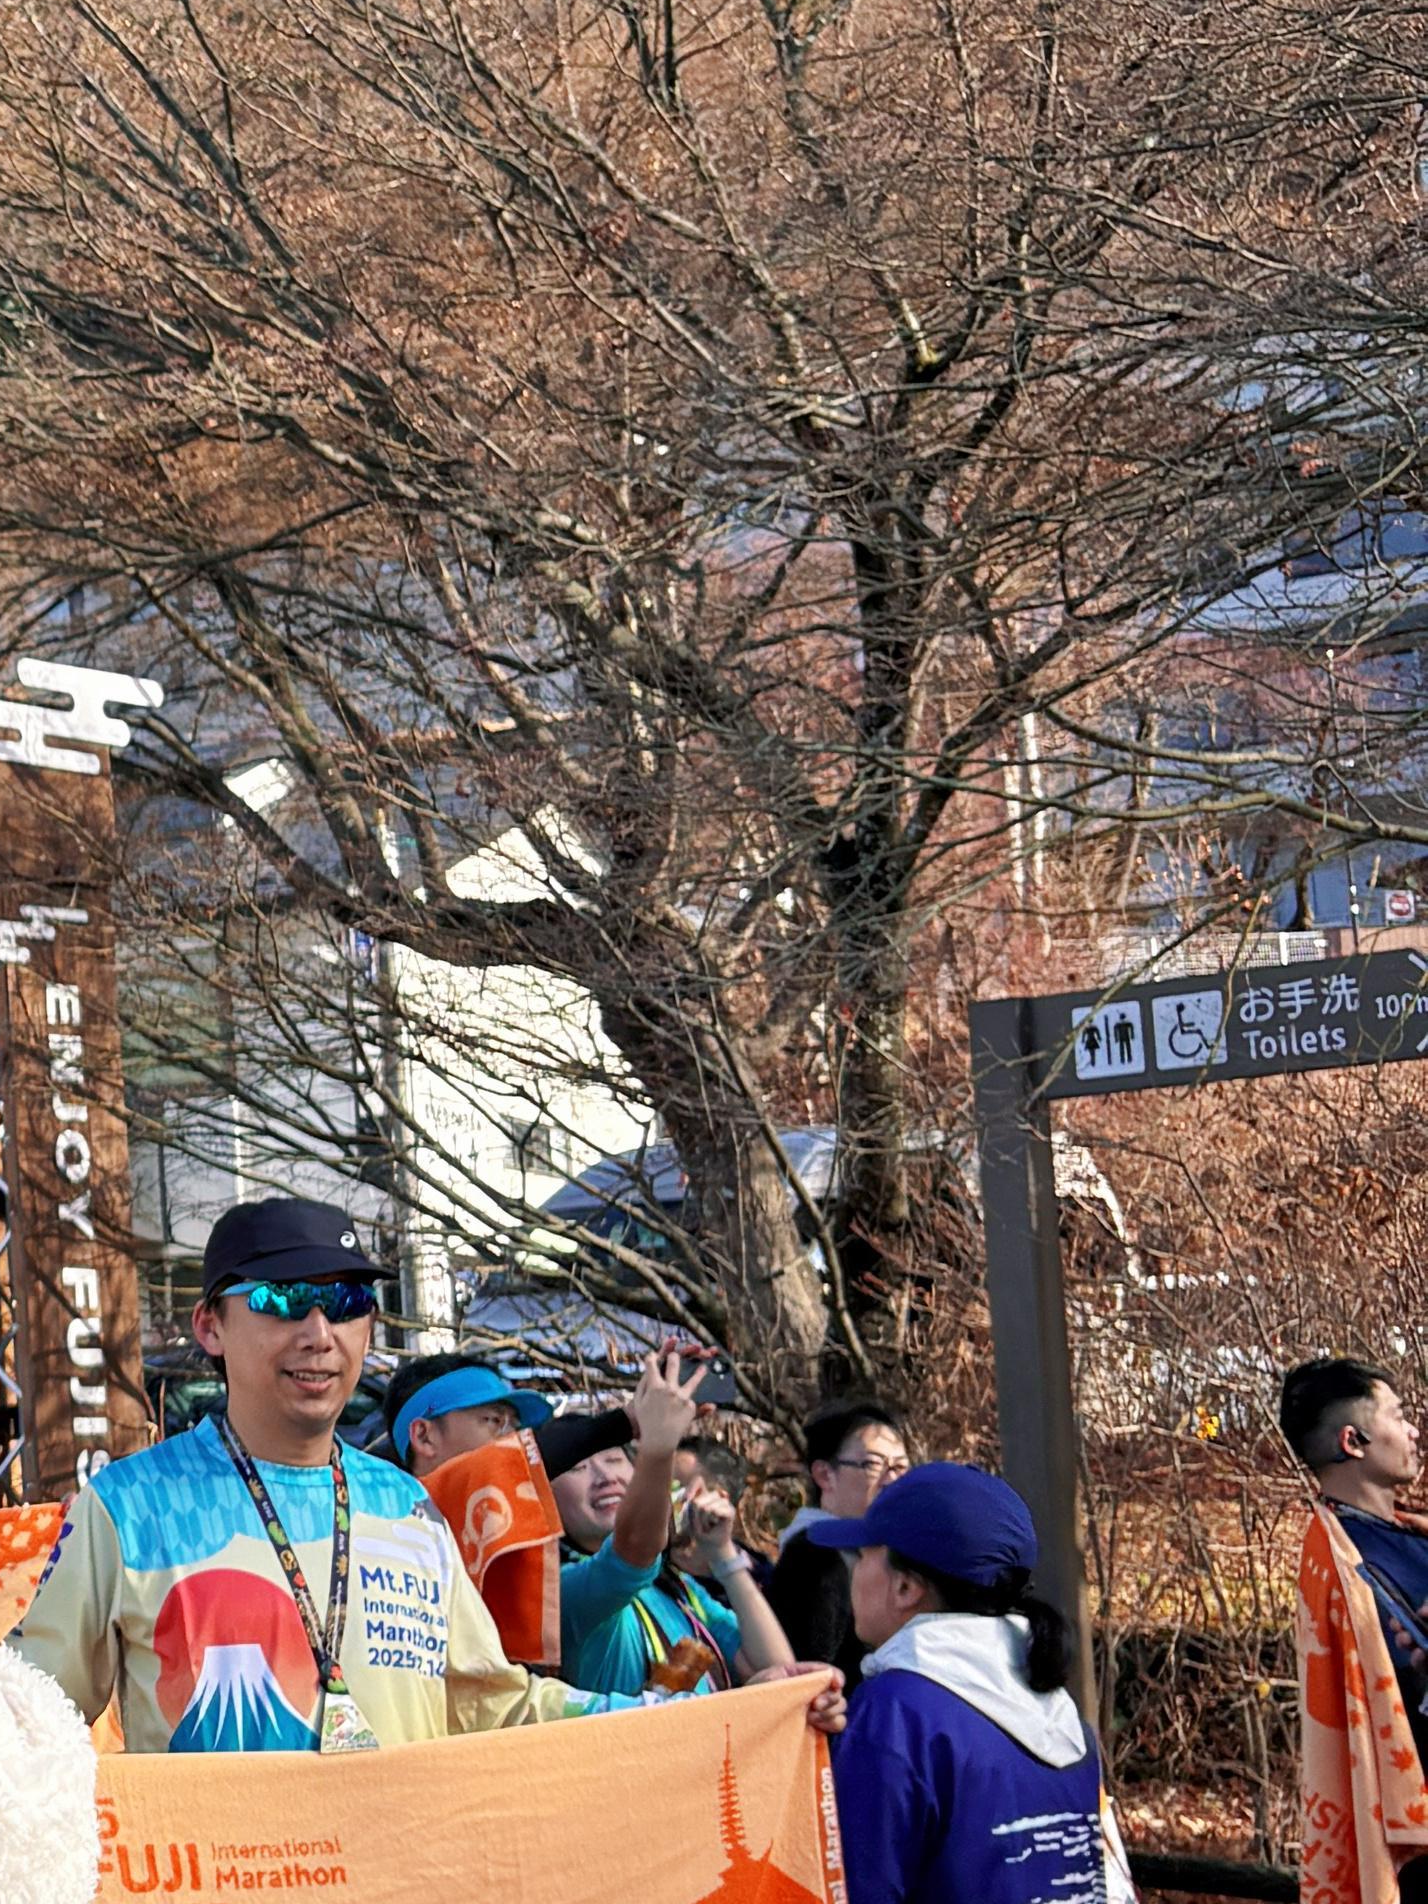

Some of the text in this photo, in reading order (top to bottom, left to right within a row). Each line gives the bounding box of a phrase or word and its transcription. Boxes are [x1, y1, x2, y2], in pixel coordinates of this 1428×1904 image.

[1237, 973, 1360, 1023] お手洗
[1242, 1024, 1347, 1060] Toilets
[46, 983, 94, 1239] ENJOY
[821, 1767, 842, 1871] Marathon
[211, 1835, 343, 1861] International
[216, 1863, 348, 1894] Marathon
